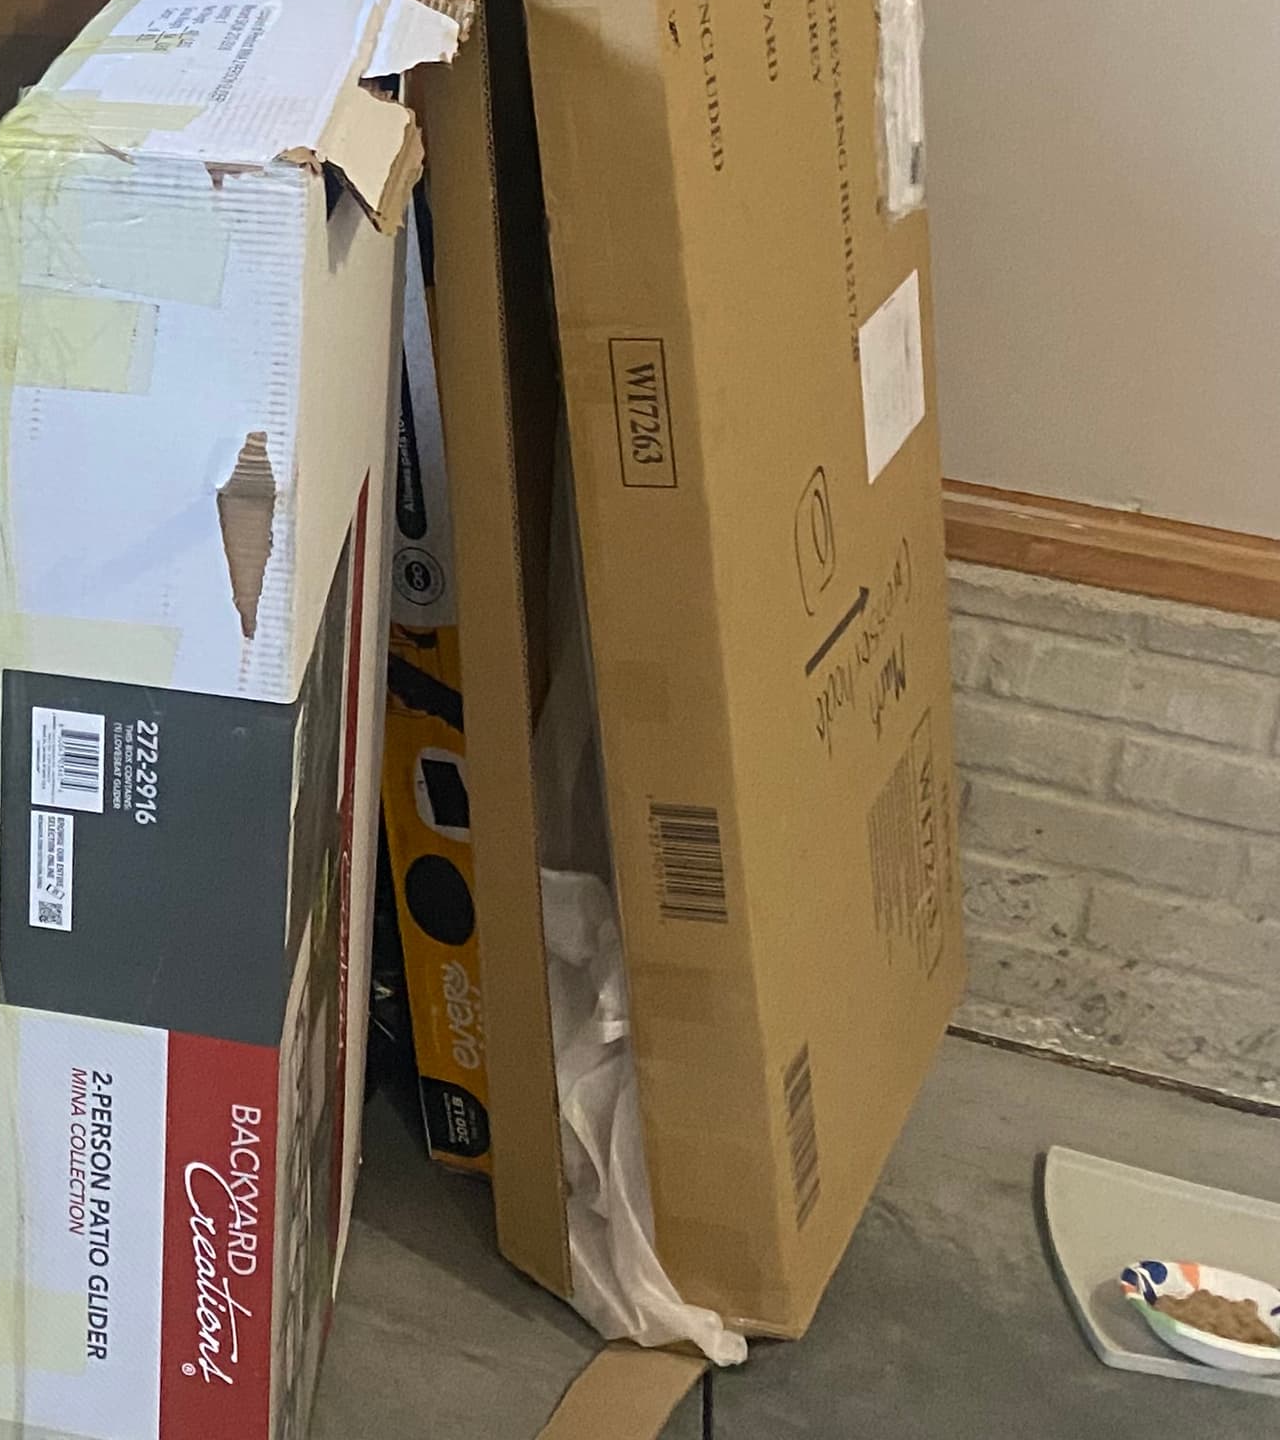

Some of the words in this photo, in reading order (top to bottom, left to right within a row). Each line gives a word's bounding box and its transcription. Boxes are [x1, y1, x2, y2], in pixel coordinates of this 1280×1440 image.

[113, 733, 122, 778] LOVESEAT
[124, 745, 133, 763] BOX
[125, 724, 134, 742] THIS
[112, 779, 121, 809] GLIDER
[135, 720, 159, 824] 272-2916
[47, 816, 55, 853] SELECTION
[47, 854, 55, 878] ONLINE
[70, 1066, 88, 1116] MINA
[89, 1071, 113, 1192] 2-PERSON
[457, 1120, 470, 1144] 200
[67, 1122, 87, 1236] COLLECTION
[226, 1104, 262, 1277] BACKYARD
[88, 1199, 111, 1267] PATIO
[183, 1161, 252, 1385] Creations
[86, 1273, 109, 1360] GLIDER
